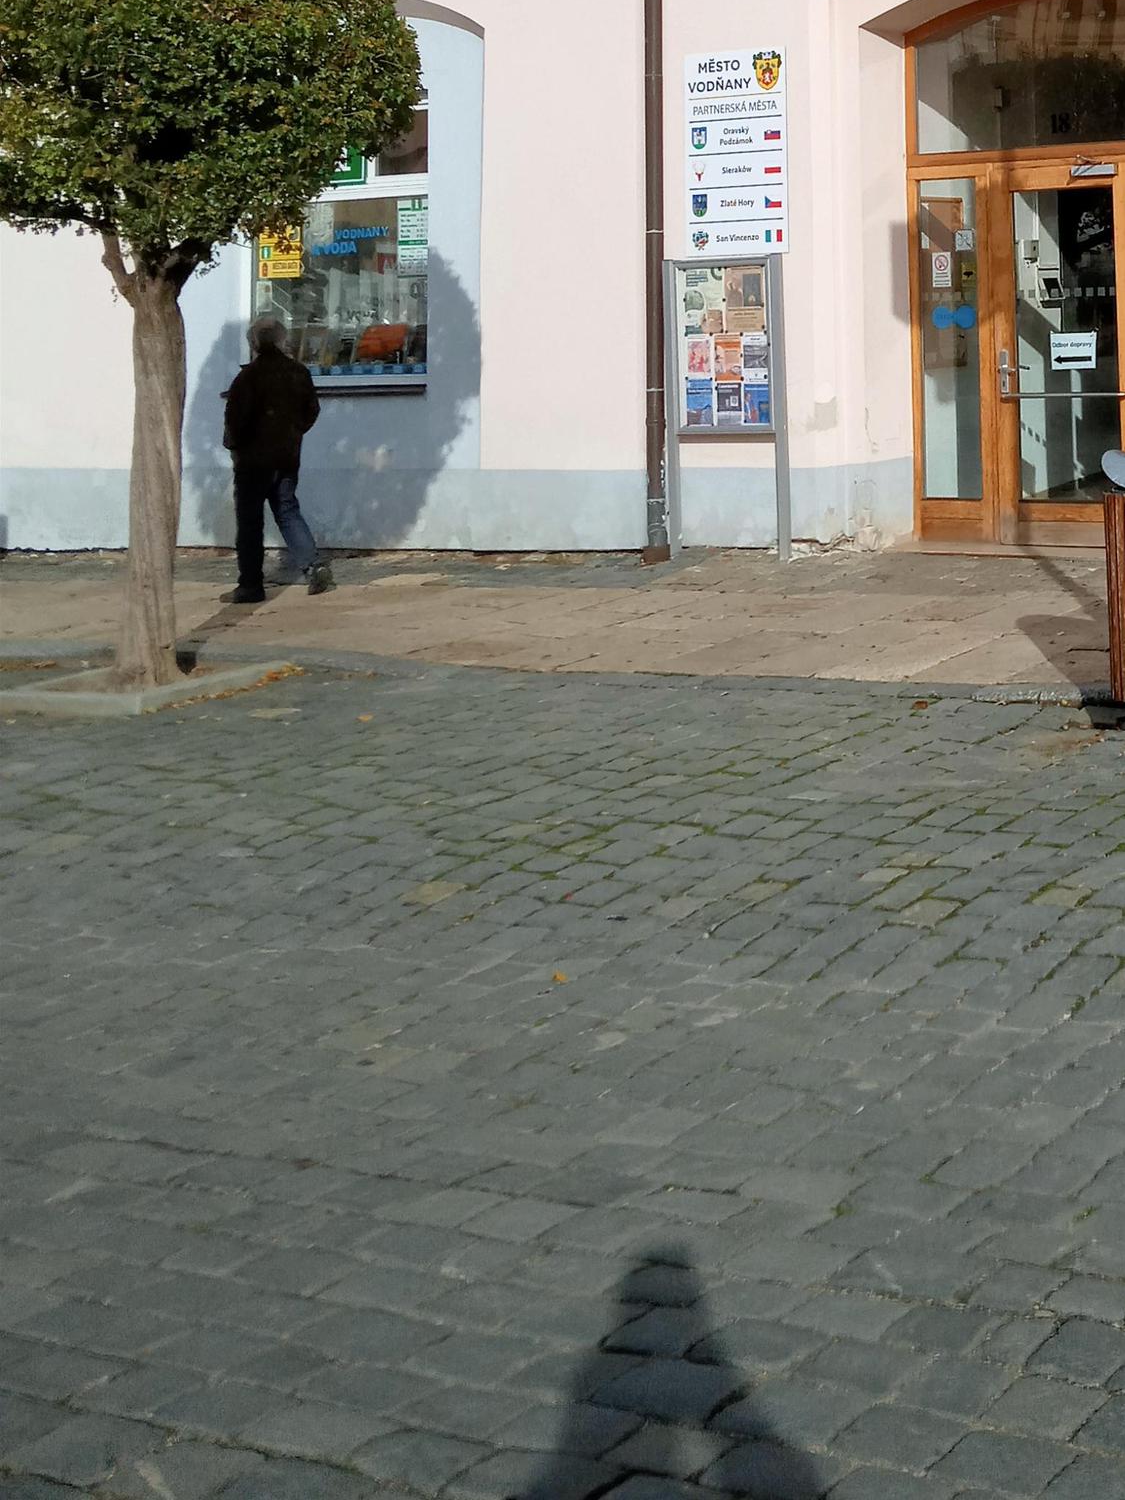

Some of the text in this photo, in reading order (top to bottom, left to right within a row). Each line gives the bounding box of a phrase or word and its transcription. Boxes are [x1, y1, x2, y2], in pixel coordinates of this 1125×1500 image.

[697, 58, 741, 74] MĚSTO
[687, 76, 752, 93] VODŇANY
[693, 99, 778, 116] PARTNERSKÁ MĚSTA
[723, 126, 749, 136] Oravský
[720, 198, 755, 207] Zlaté Hory
[729, 233, 759, 242] Vincenzo
